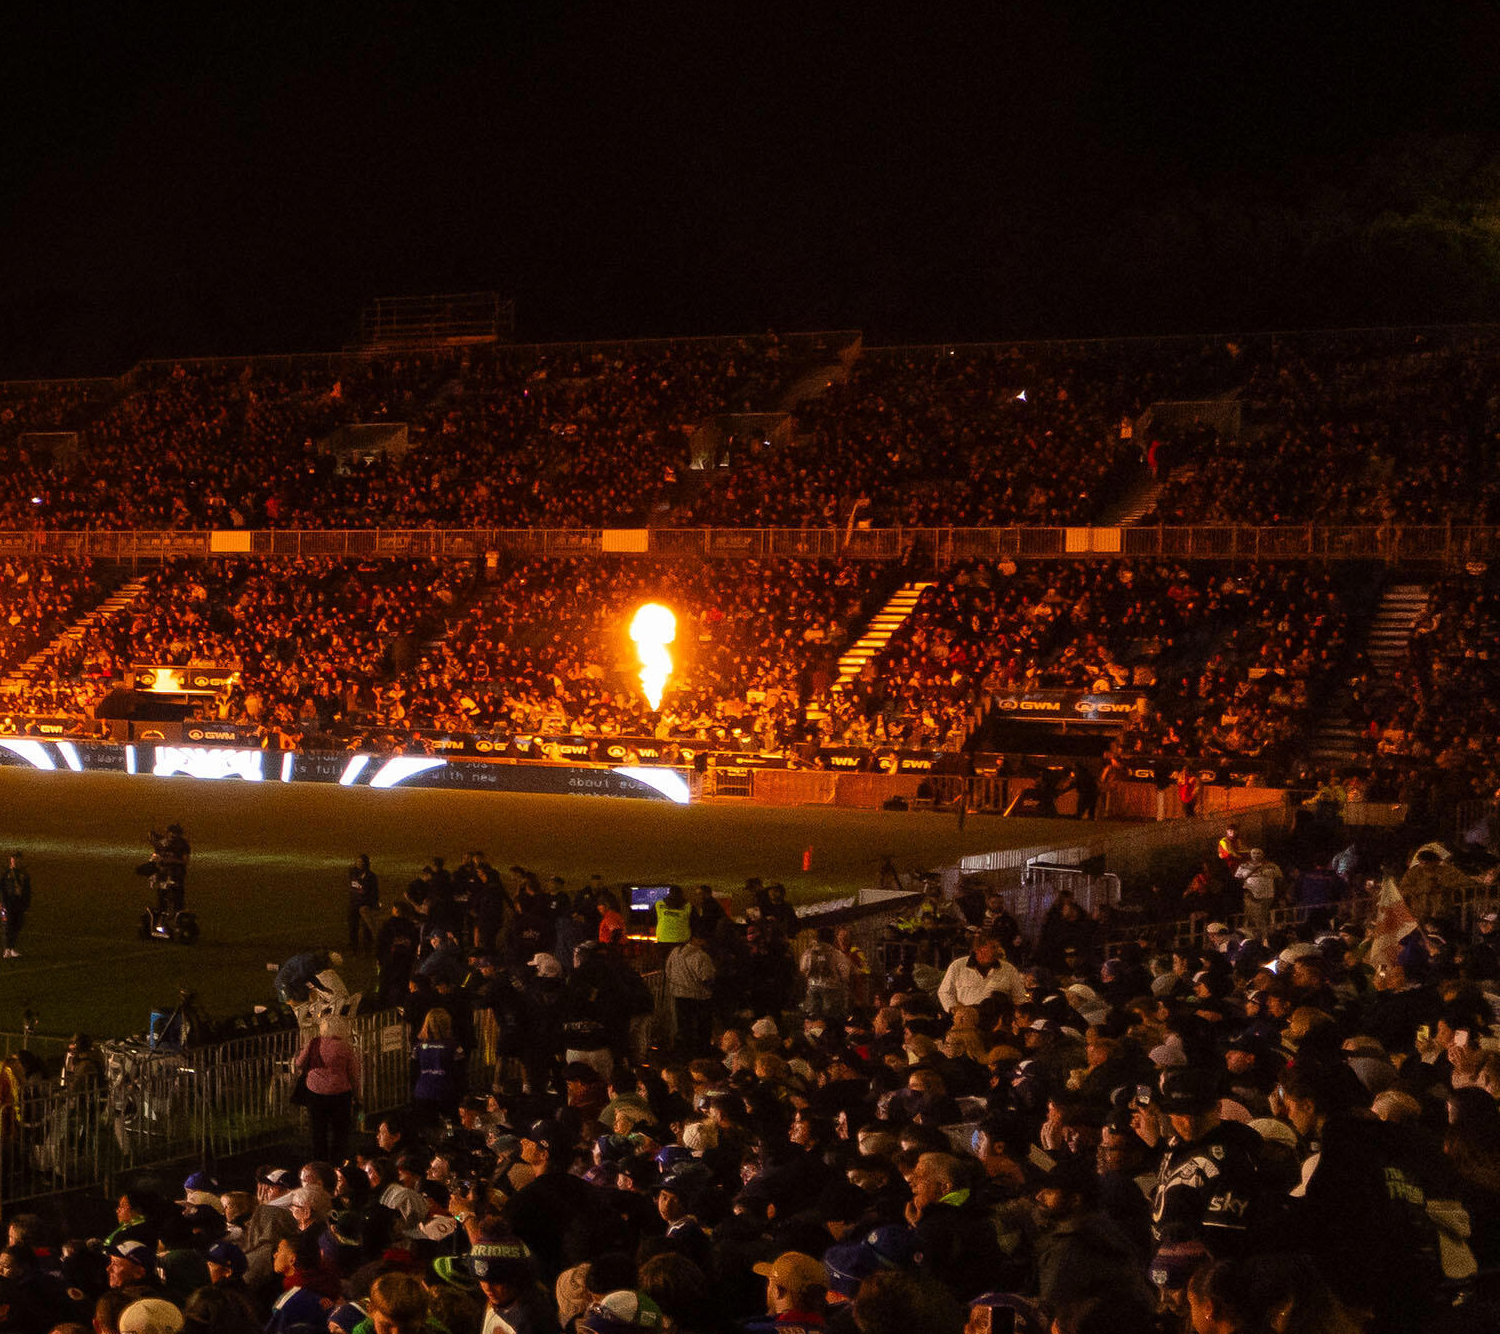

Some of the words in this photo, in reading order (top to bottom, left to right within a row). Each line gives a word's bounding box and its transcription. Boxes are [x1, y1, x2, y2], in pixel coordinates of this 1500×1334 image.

[1019, 702, 1061, 711] GWM
[204, 731, 236, 741] GWM
[1208, 1191, 1249, 1218] sky
